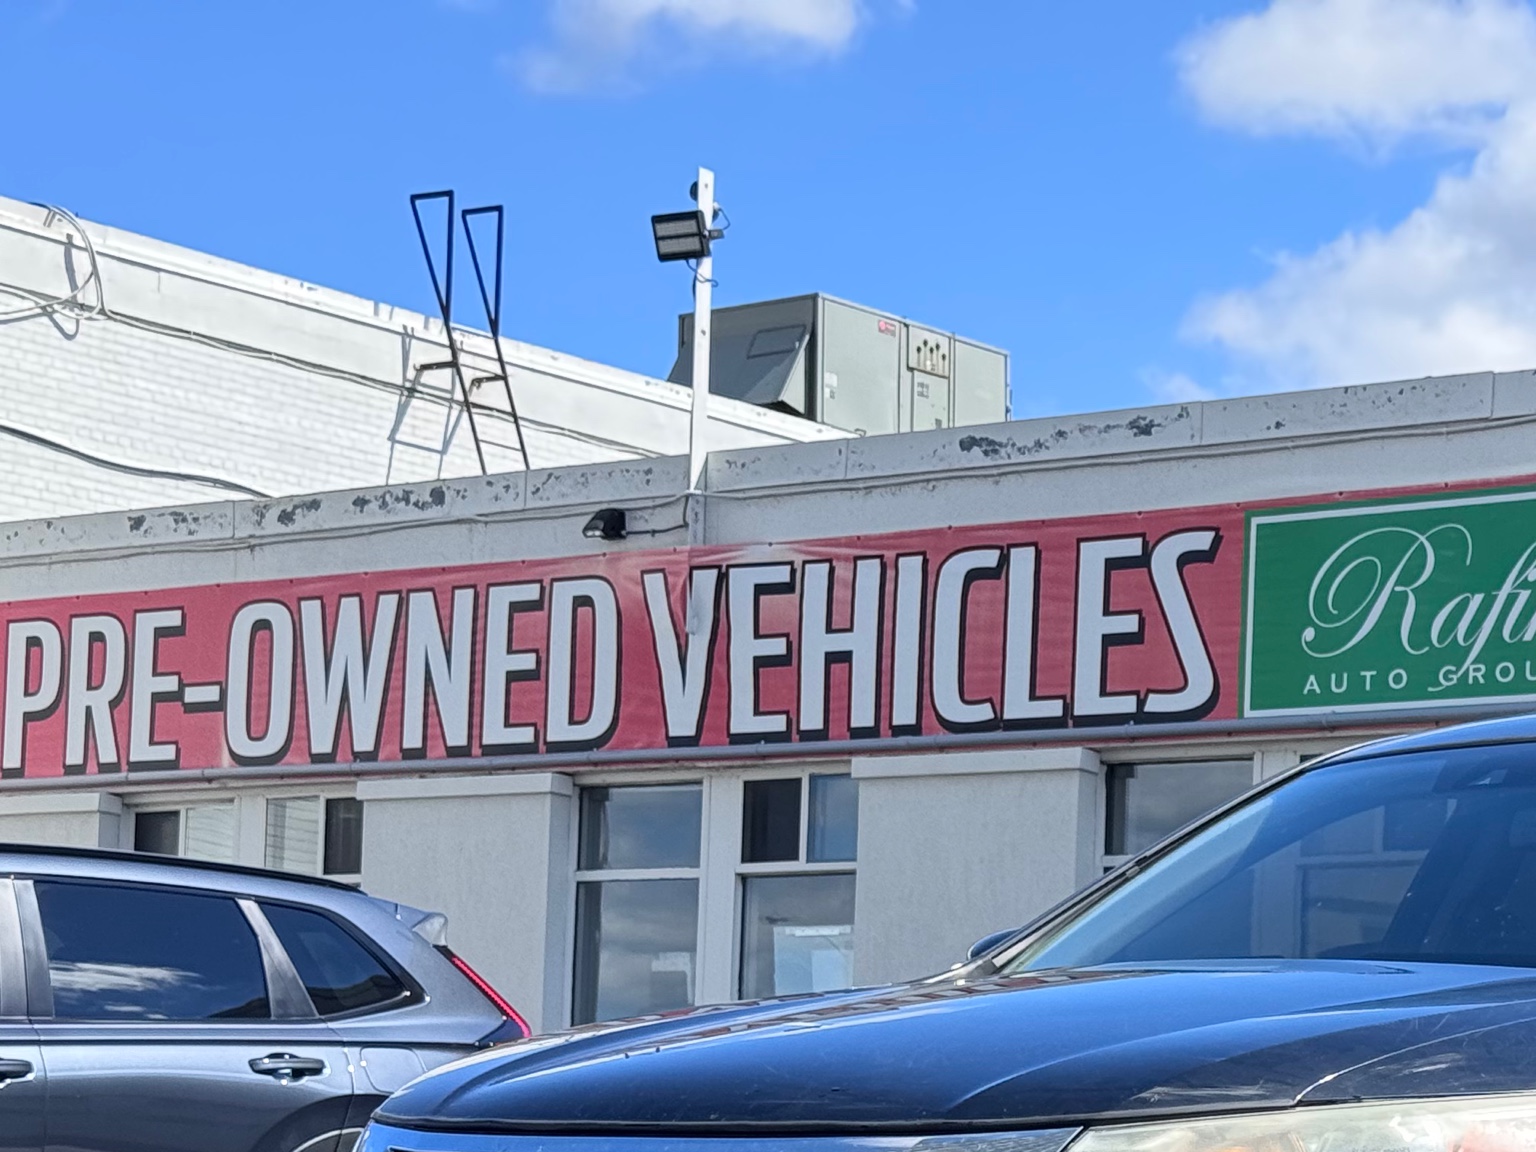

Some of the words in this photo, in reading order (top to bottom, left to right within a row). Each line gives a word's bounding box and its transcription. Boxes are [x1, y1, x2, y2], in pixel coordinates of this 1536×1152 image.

[1, 575, 623, 778] PRE-OWNED
[641, 527, 1221, 748] VEHICLES
[1303, 668, 1408, 695] AUTO
